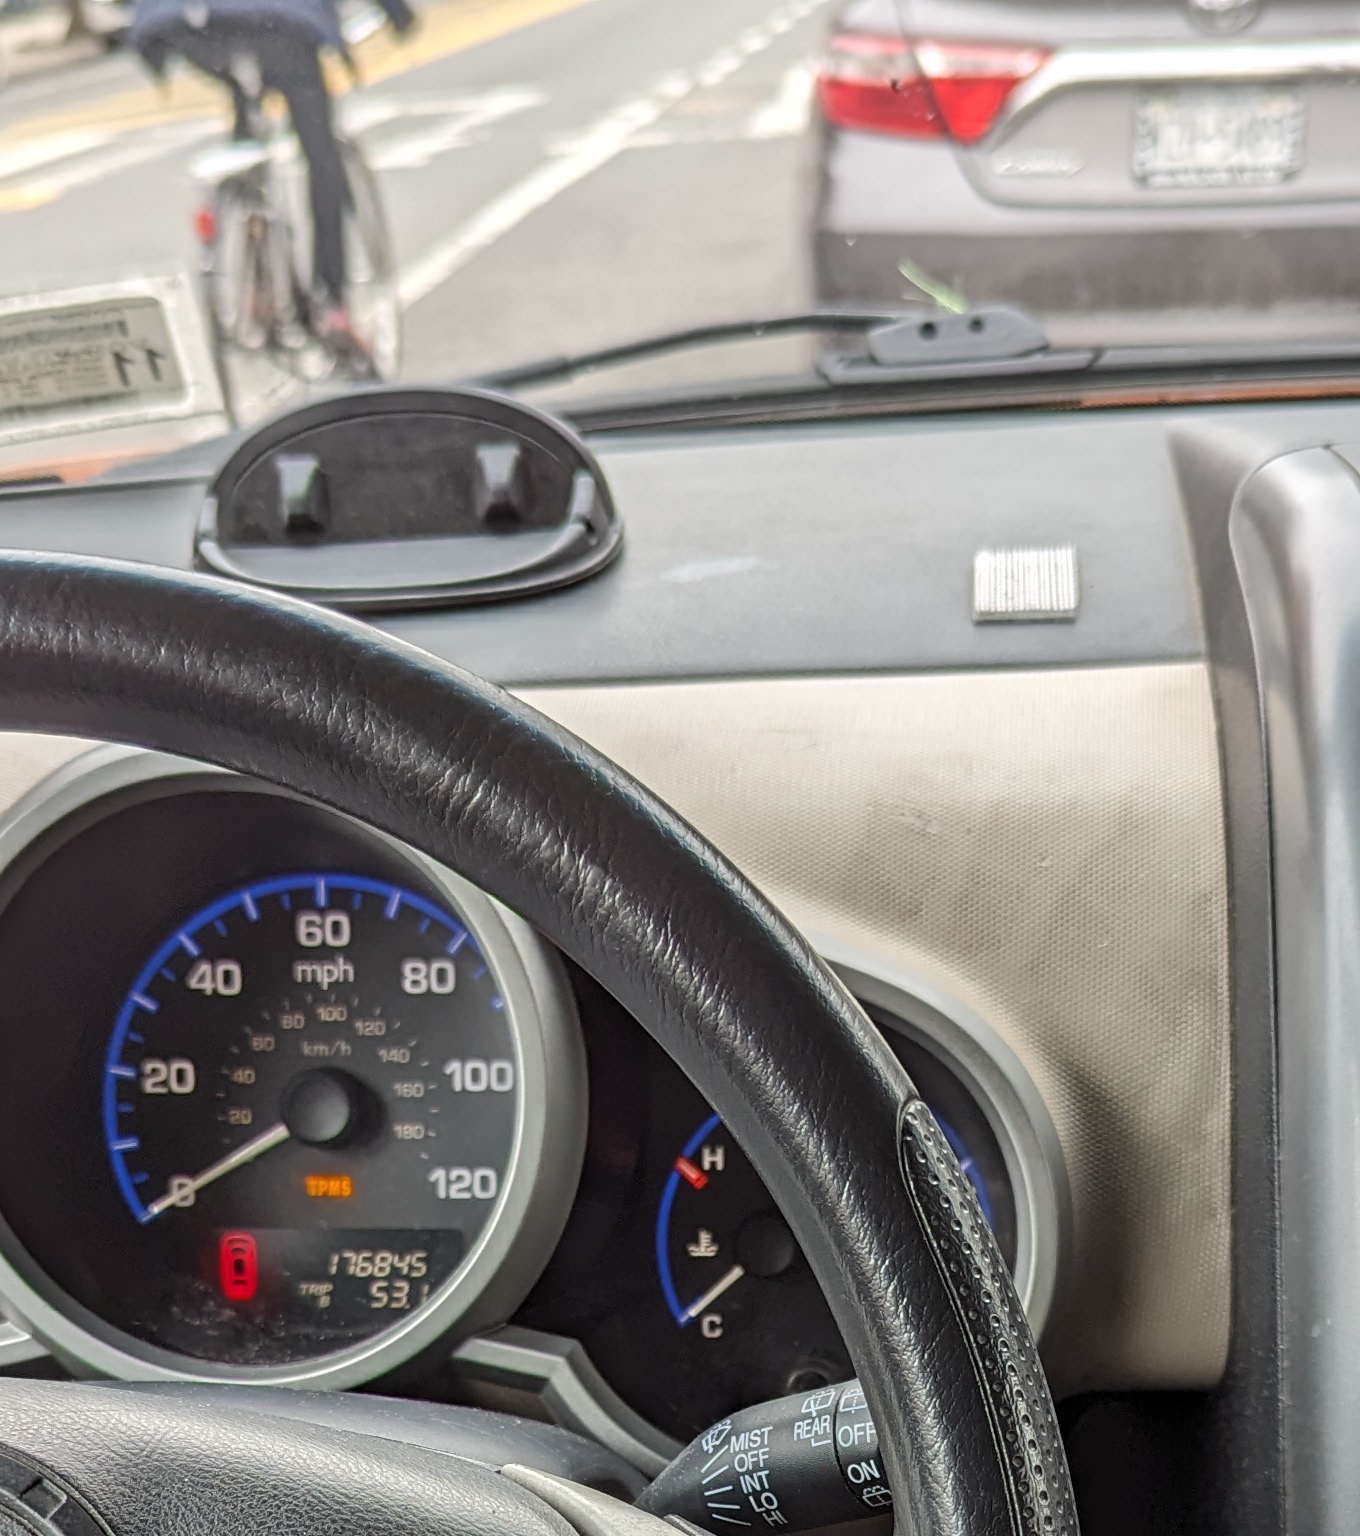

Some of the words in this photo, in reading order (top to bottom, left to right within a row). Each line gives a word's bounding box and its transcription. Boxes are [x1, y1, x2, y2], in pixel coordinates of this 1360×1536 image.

[297, 911, 350, 946] 60
[187, 959, 242, 996] 40
[295, 959, 353, 989] mph
[401, 959, 456, 995] 80
[316, 1006, 348, 1022] 100
[353, 1020, 386, 1036] 120
[303, 1040, 352, 1057] km/h
[378, 1048, 410, 1064] 140
[143, 1059, 196, 1094] 20
[442, 1059, 514, 1092] 100
[394, 1083, 425, 1098] 160
[702, 1149, 724, 1170] H
[169, 1176, 196, 1207] 0
[304, 1174, 353, 1198] TPMS
[429, 1166, 497, 1200] 120
[329, 1250, 428, 1278] 176845
[299, 1282, 334, 1297] TRIP
[702, 1318, 722, 1338] C
[729, 1426, 773, 1454] MIST
[793, 1414, 831, 1441] REAR
[838, 1421, 878, 1448] OFF
[734, 1447, 770, 1473] OFF
[847, 1459, 881, 1484] ON
[739, 1470, 770, 1494] INT
[748, 1491, 779, 1513] LO
[762, 1510, 789, 1527] HI
